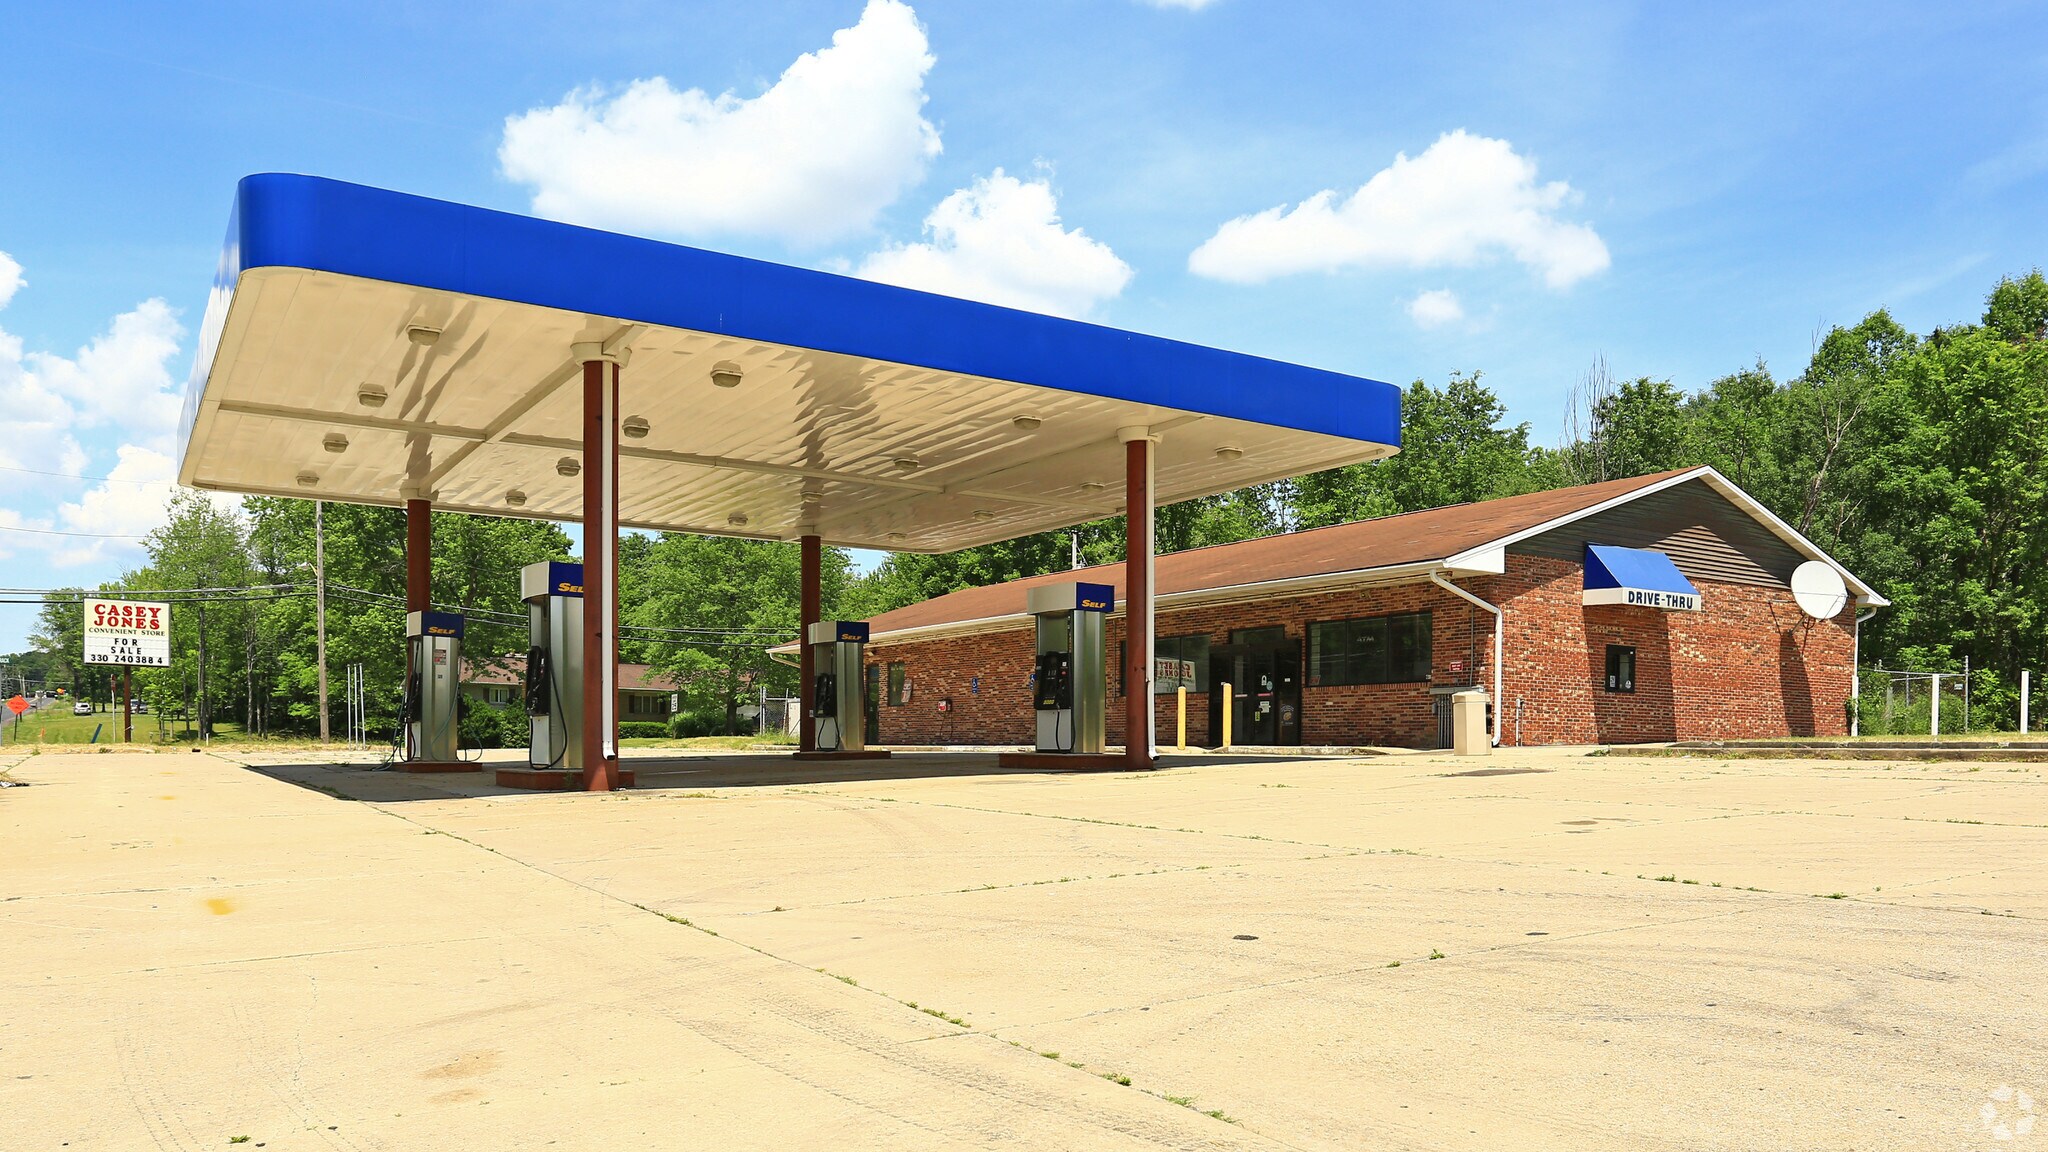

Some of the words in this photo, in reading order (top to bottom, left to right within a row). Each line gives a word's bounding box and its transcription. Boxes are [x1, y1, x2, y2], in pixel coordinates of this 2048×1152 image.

[558, 582, 584, 592] SEL
[1081, 599, 1107, 609] SELF
[1628, 590, 1694, 610] DRIVE-THRU
[94, 604, 161, 618] CASEY
[94, 616, 160, 629] JONES
[88, 627, 137, 635] CONVENIENT
[428, 626, 455, 634] SELF
[841, 633, 862, 641] SELF
[114, 638, 138, 646] FOR
[111, 646, 142, 655] SALE
[91, 654, 108, 662] 330
